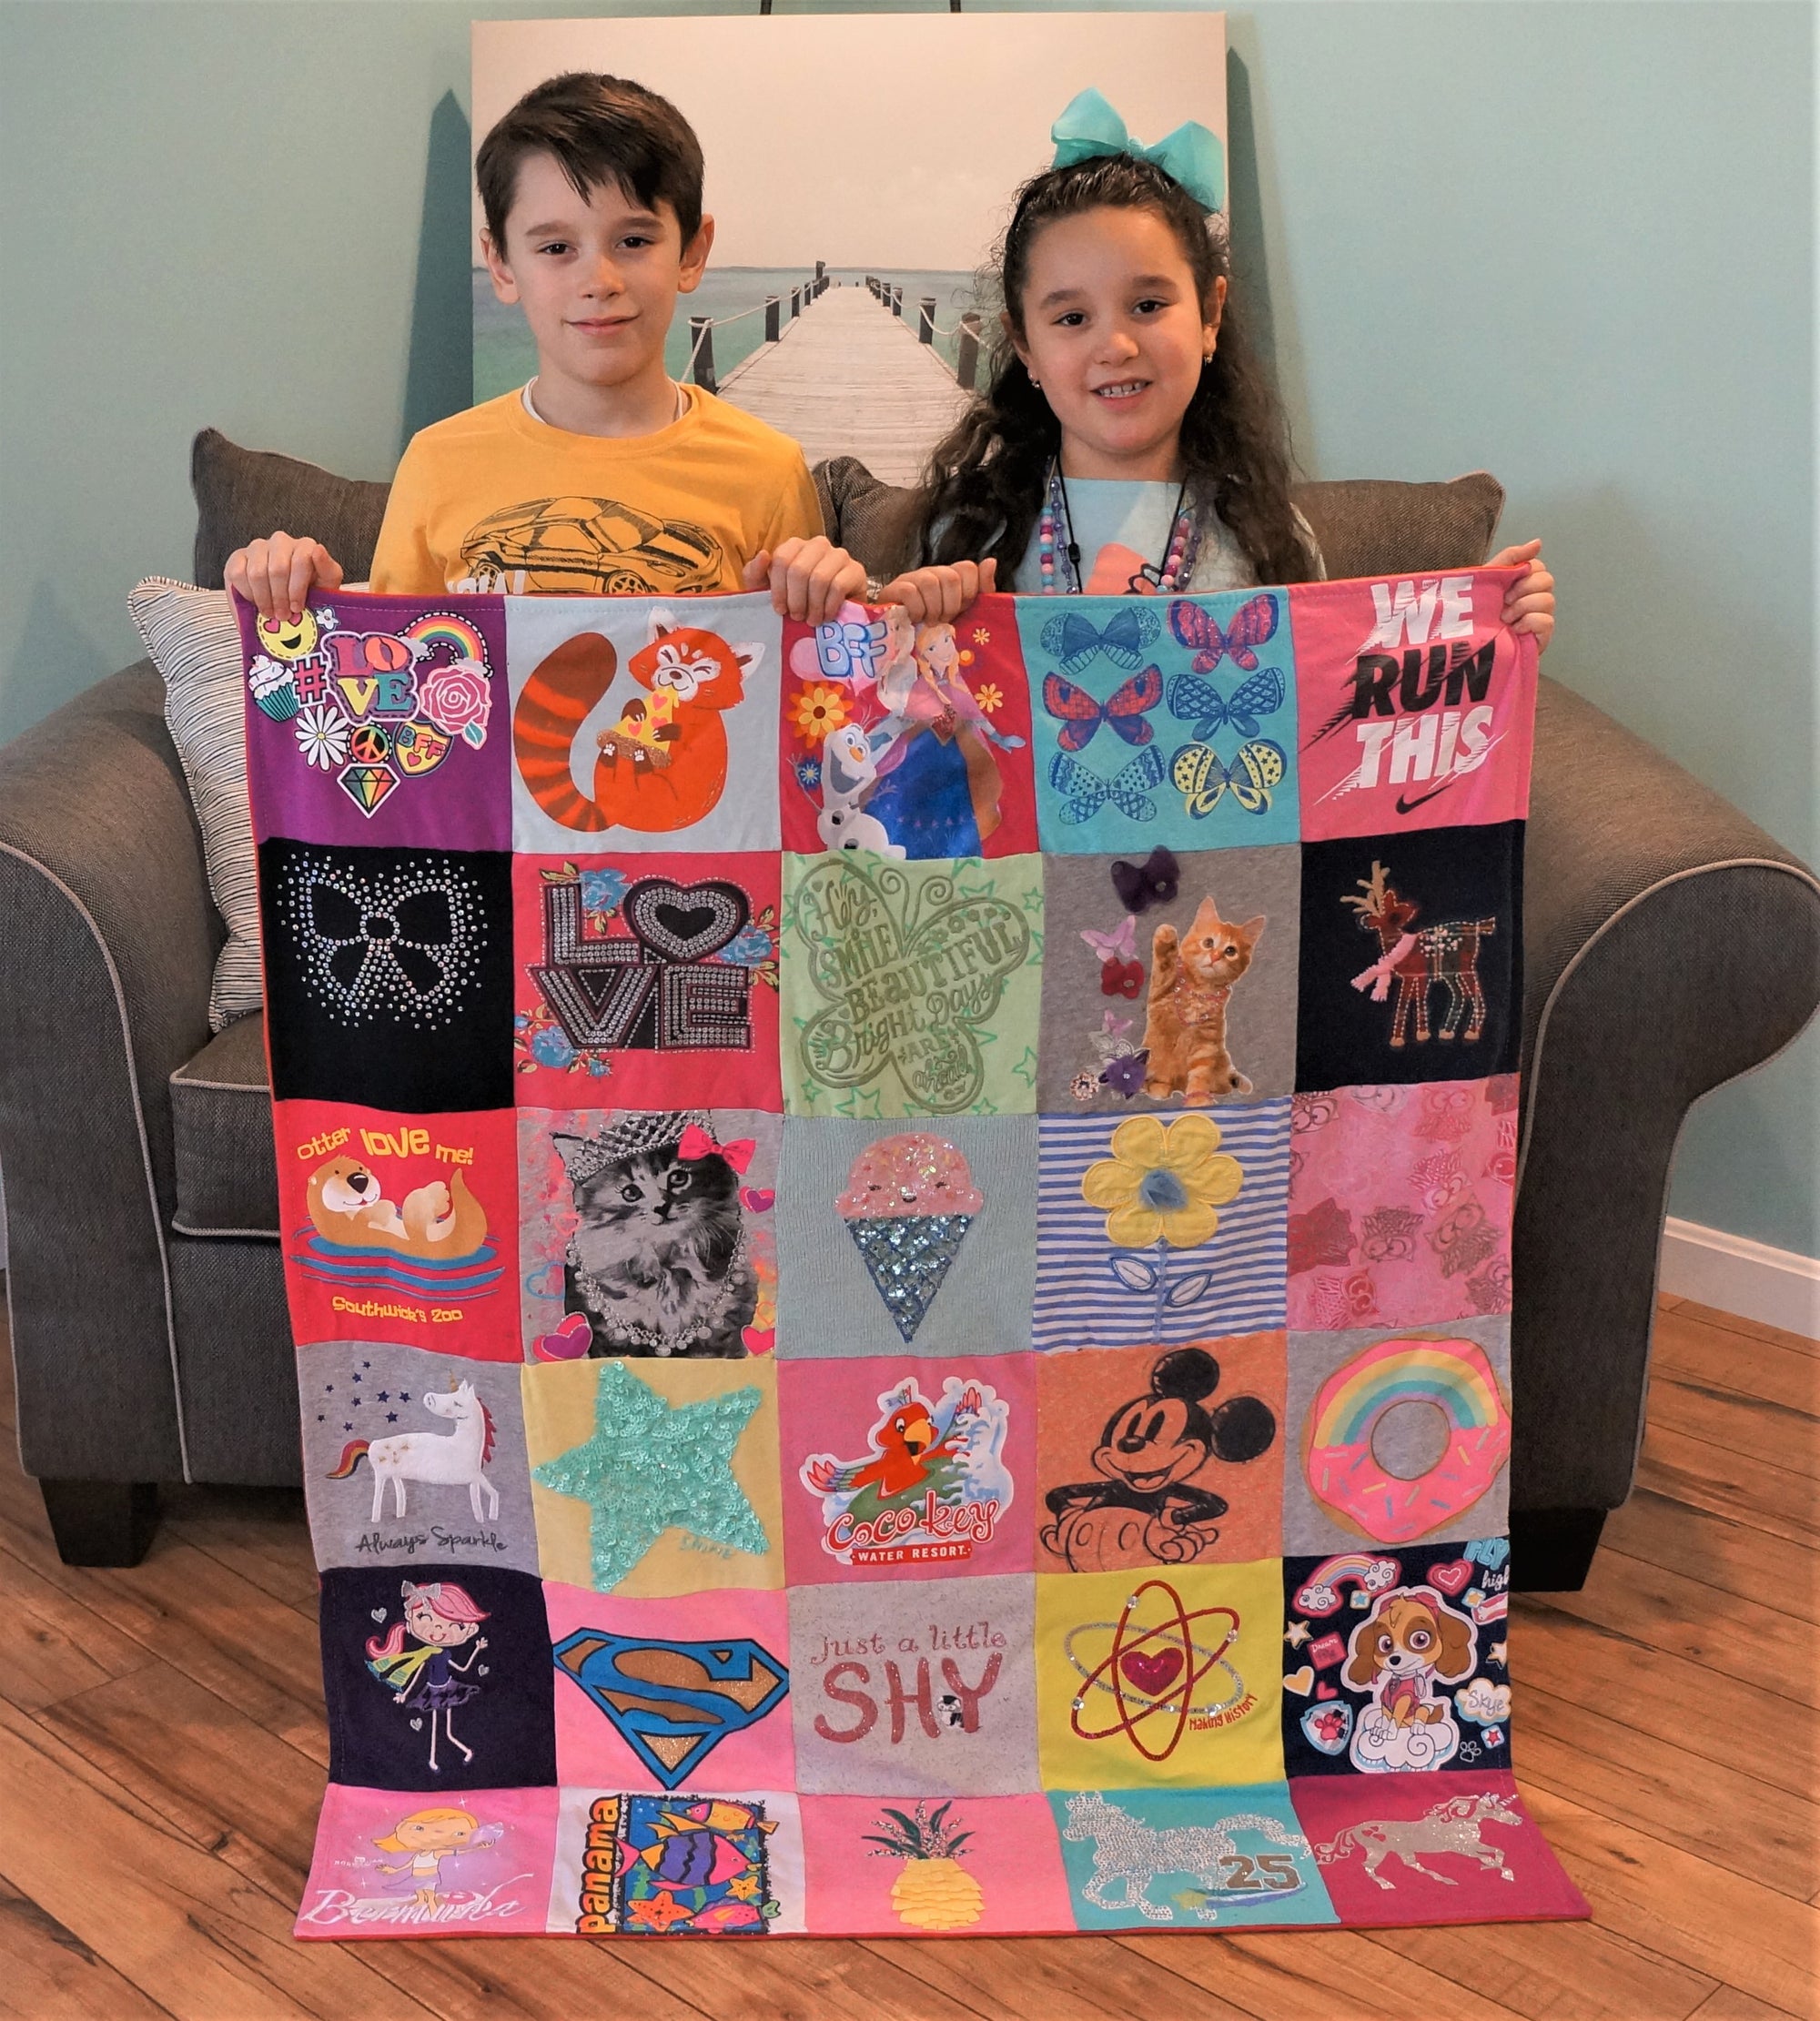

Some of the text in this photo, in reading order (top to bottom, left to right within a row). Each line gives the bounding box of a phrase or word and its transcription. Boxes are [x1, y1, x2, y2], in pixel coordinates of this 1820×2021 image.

[1360, 575, 1474, 649] WE
[1350, 637, 1495, 719] RUN
[397, 725, 446, 759] BFF
[1356, 705, 1495, 789] THIS
[359, 1127, 430, 1158] love
[435, 1144, 474, 1166] me!
[332, 1296, 463, 1323] Southwick's Zoo
[355, 1526, 509, 1554] Always Sparkle
[858, 1545, 964, 1562] WATER RESORT
[810, 1621, 1008, 1665] just a little
[814, 1652, 1003, 1744] SHY
[1218, 1854, 1302, 1891] 25
